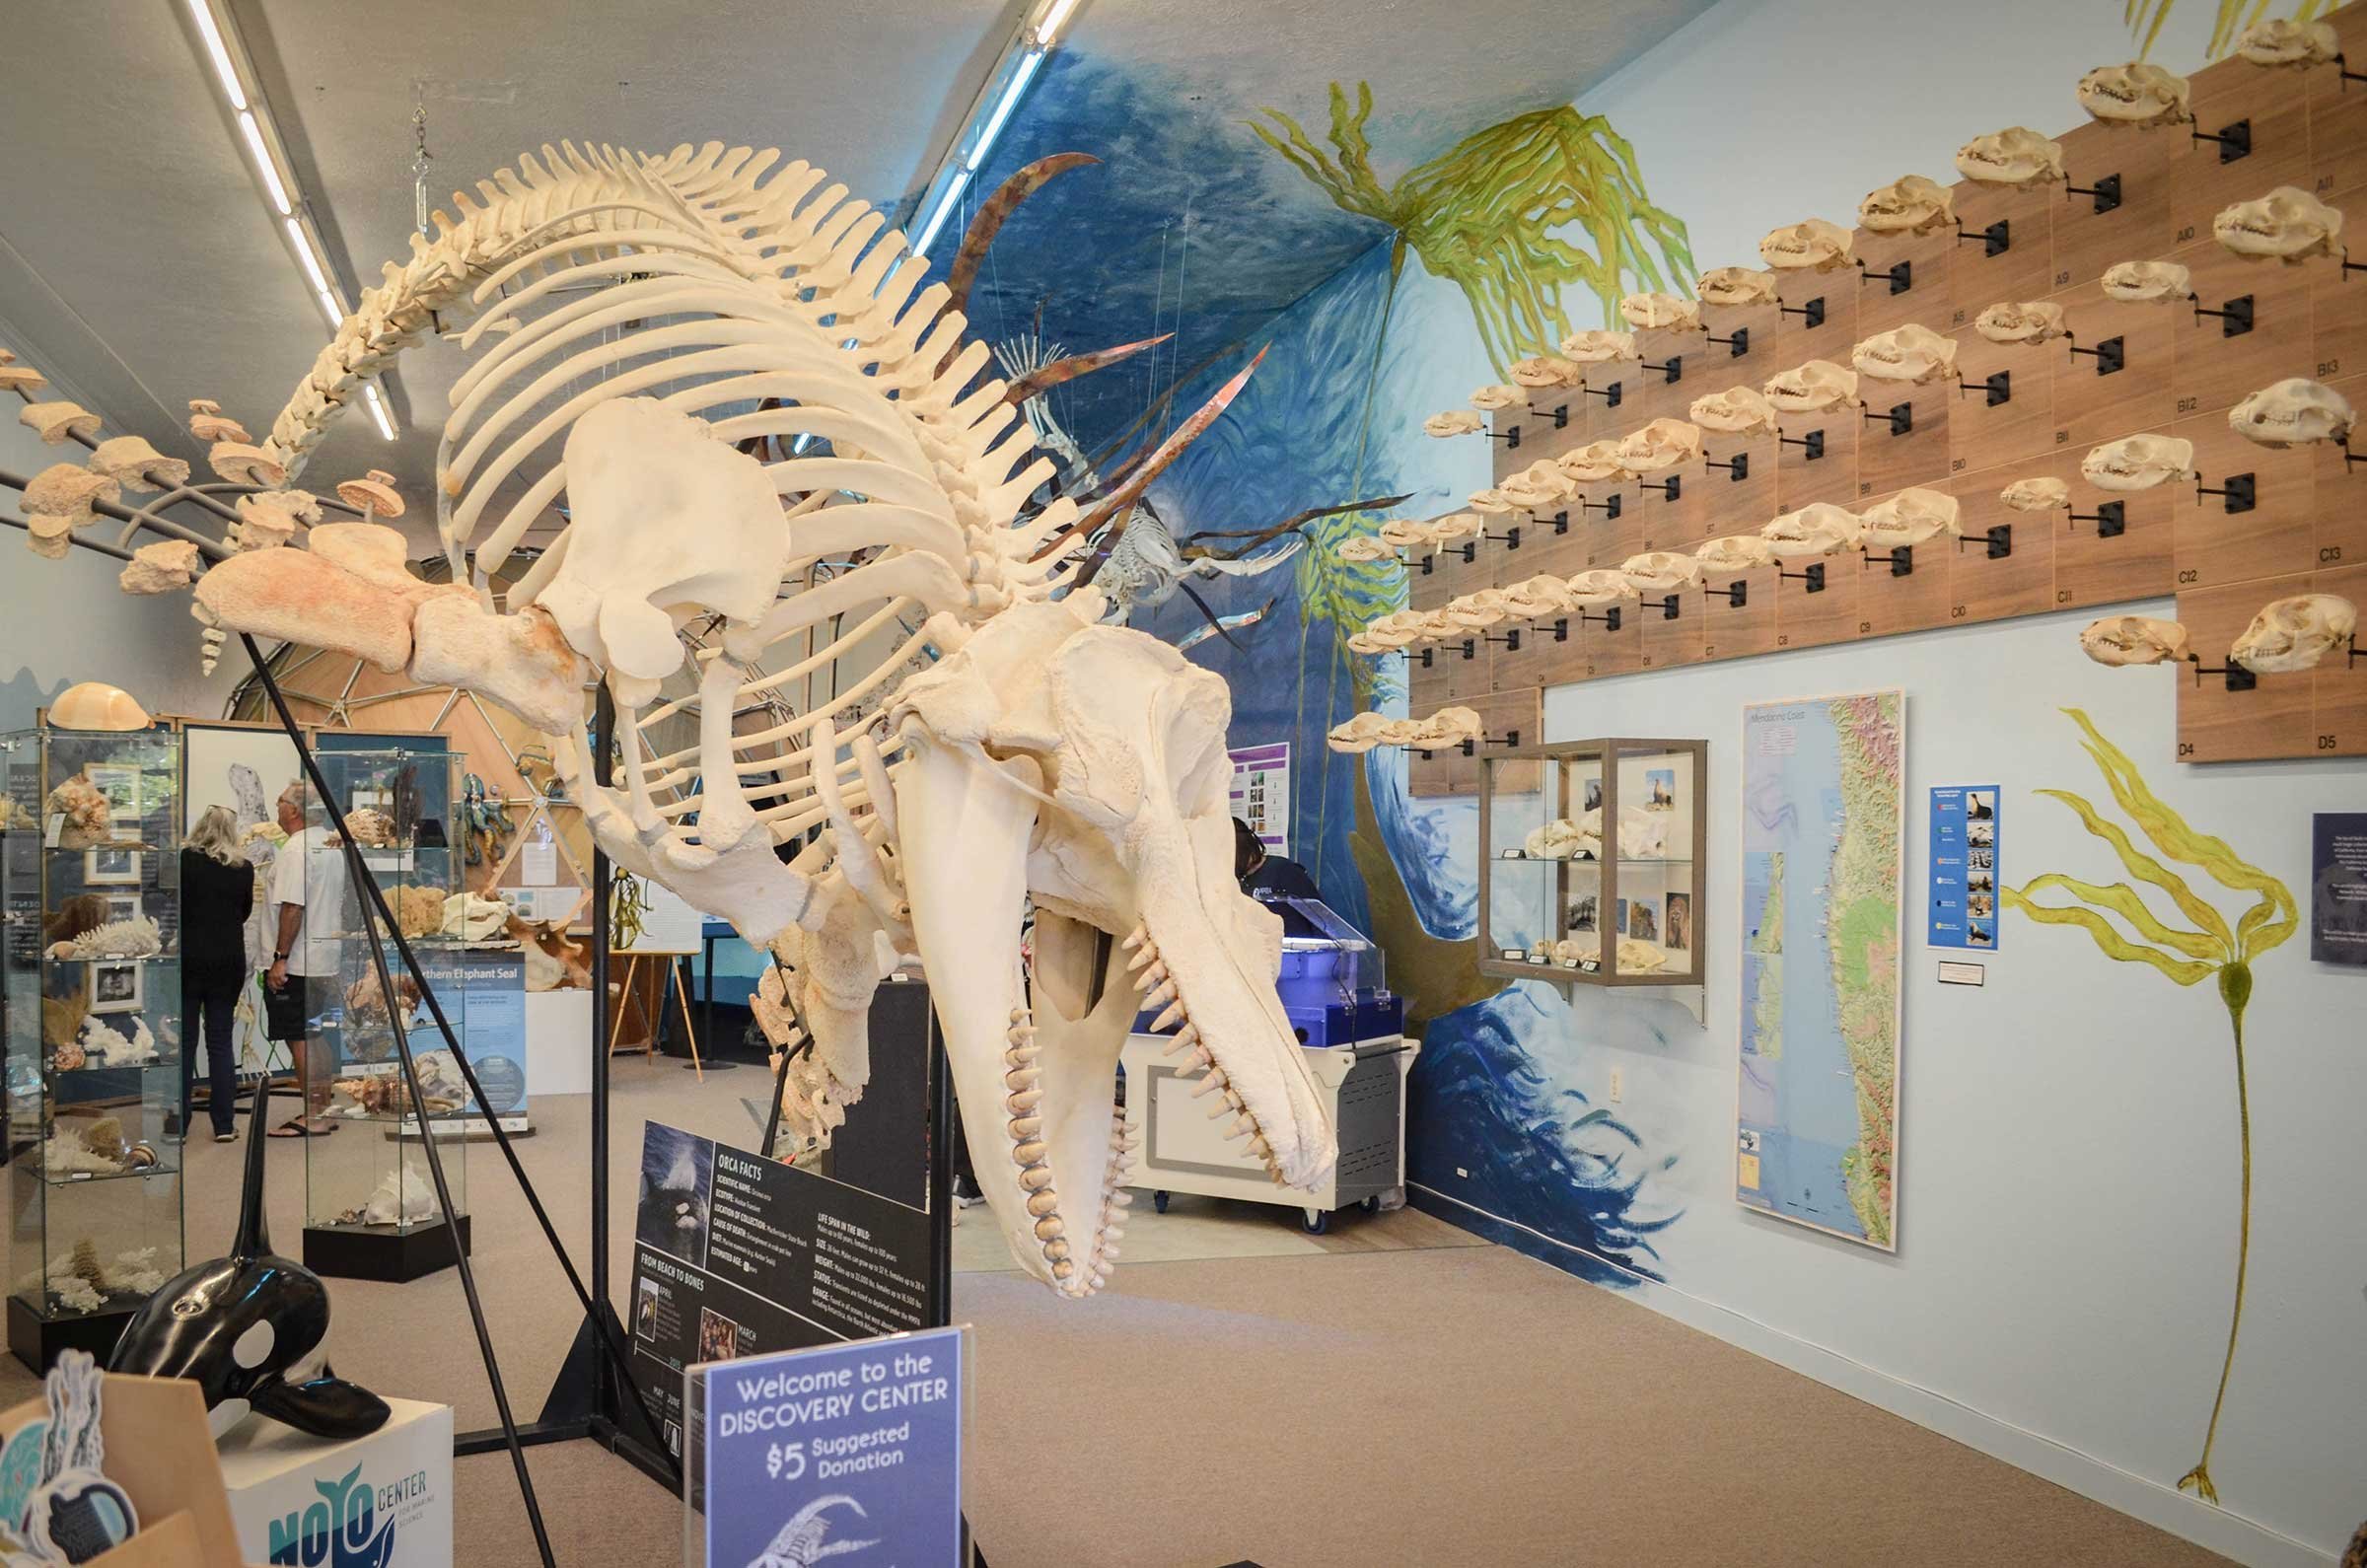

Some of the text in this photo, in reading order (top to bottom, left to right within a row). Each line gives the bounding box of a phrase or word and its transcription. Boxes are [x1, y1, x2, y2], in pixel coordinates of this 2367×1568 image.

[2177, 226, 2194, 244] A10
[2055, 270, 2070, 285] A9
[2318, 359, 2339, 377] B13
[2177, 397, 2197, 412] B12
[2319, 546, 2341, 562] C13
[2178, 570, 2197, 584] C12
[2057, 590, 2072, 603] C11
[1951, 606, 1966, 618] C10
[1787, 710, 1806, 720] Coast
[2178, 743, 2194, 755] D4
[2318, 735, 2336, 749] D5
[409, 968, 452, 979] rthern
[496, 968, 518, 979] Seal
[719, 1154, 762, 1180] ORCA FACTS
[717, 1175, 738, 1189] SCIENTIFIC
[713, 1218, 726, 1230] CAUSE
[714, 1204, 734, 1218] LOCATION
[735, 1211, 741, 1220] OF
[741, 1214, 766, 1231] COLLECTION:
[818, 1212, 827, 1224] LIFE
[828, 1216, 840, 1228] SPAN
[841, 1222, 846, 1231] IN
[847, 1224, 856, 1235] THE
[711, 1247, 733, 1262] ESTIMATED
[815, 1253, 833, 1269] WEIGHT:
[641, 1252, 657, 1269] FROM
[658, 1260, 676, 1278] BEACH
[677, 1269, 683, 1282] TO
[684, 1272, 704, 1291] BONES
[814, 1270, 831, 1285] STATUS:
[659, 1286, 673, 1300] APRIL
[813, 1286, 829, 1301] RANGE:
[739, 1324, 756, 1341] MARCH
[738, 1353, 933, 1403] Welcome to the
[653, 1386, 664, 1398] MAY
[668, 1393, 680, 1408] JUNE
[720, 1393, 854, 1438] DISCOVERY
[861, 1378, 948, 1413] CENTER
[812, 1422, 909, 1458] Suggested
[766, 1443, 807, 1480] $5
[818, 1450, 903, 1479] Donation
[378, 1470, 427, 1513] CENTER
[268, 1460, 374, 1568] NOYO
[398, 1506, 410, 1518] FOR
[398, 1513, 424, 1529] SCIENCE
